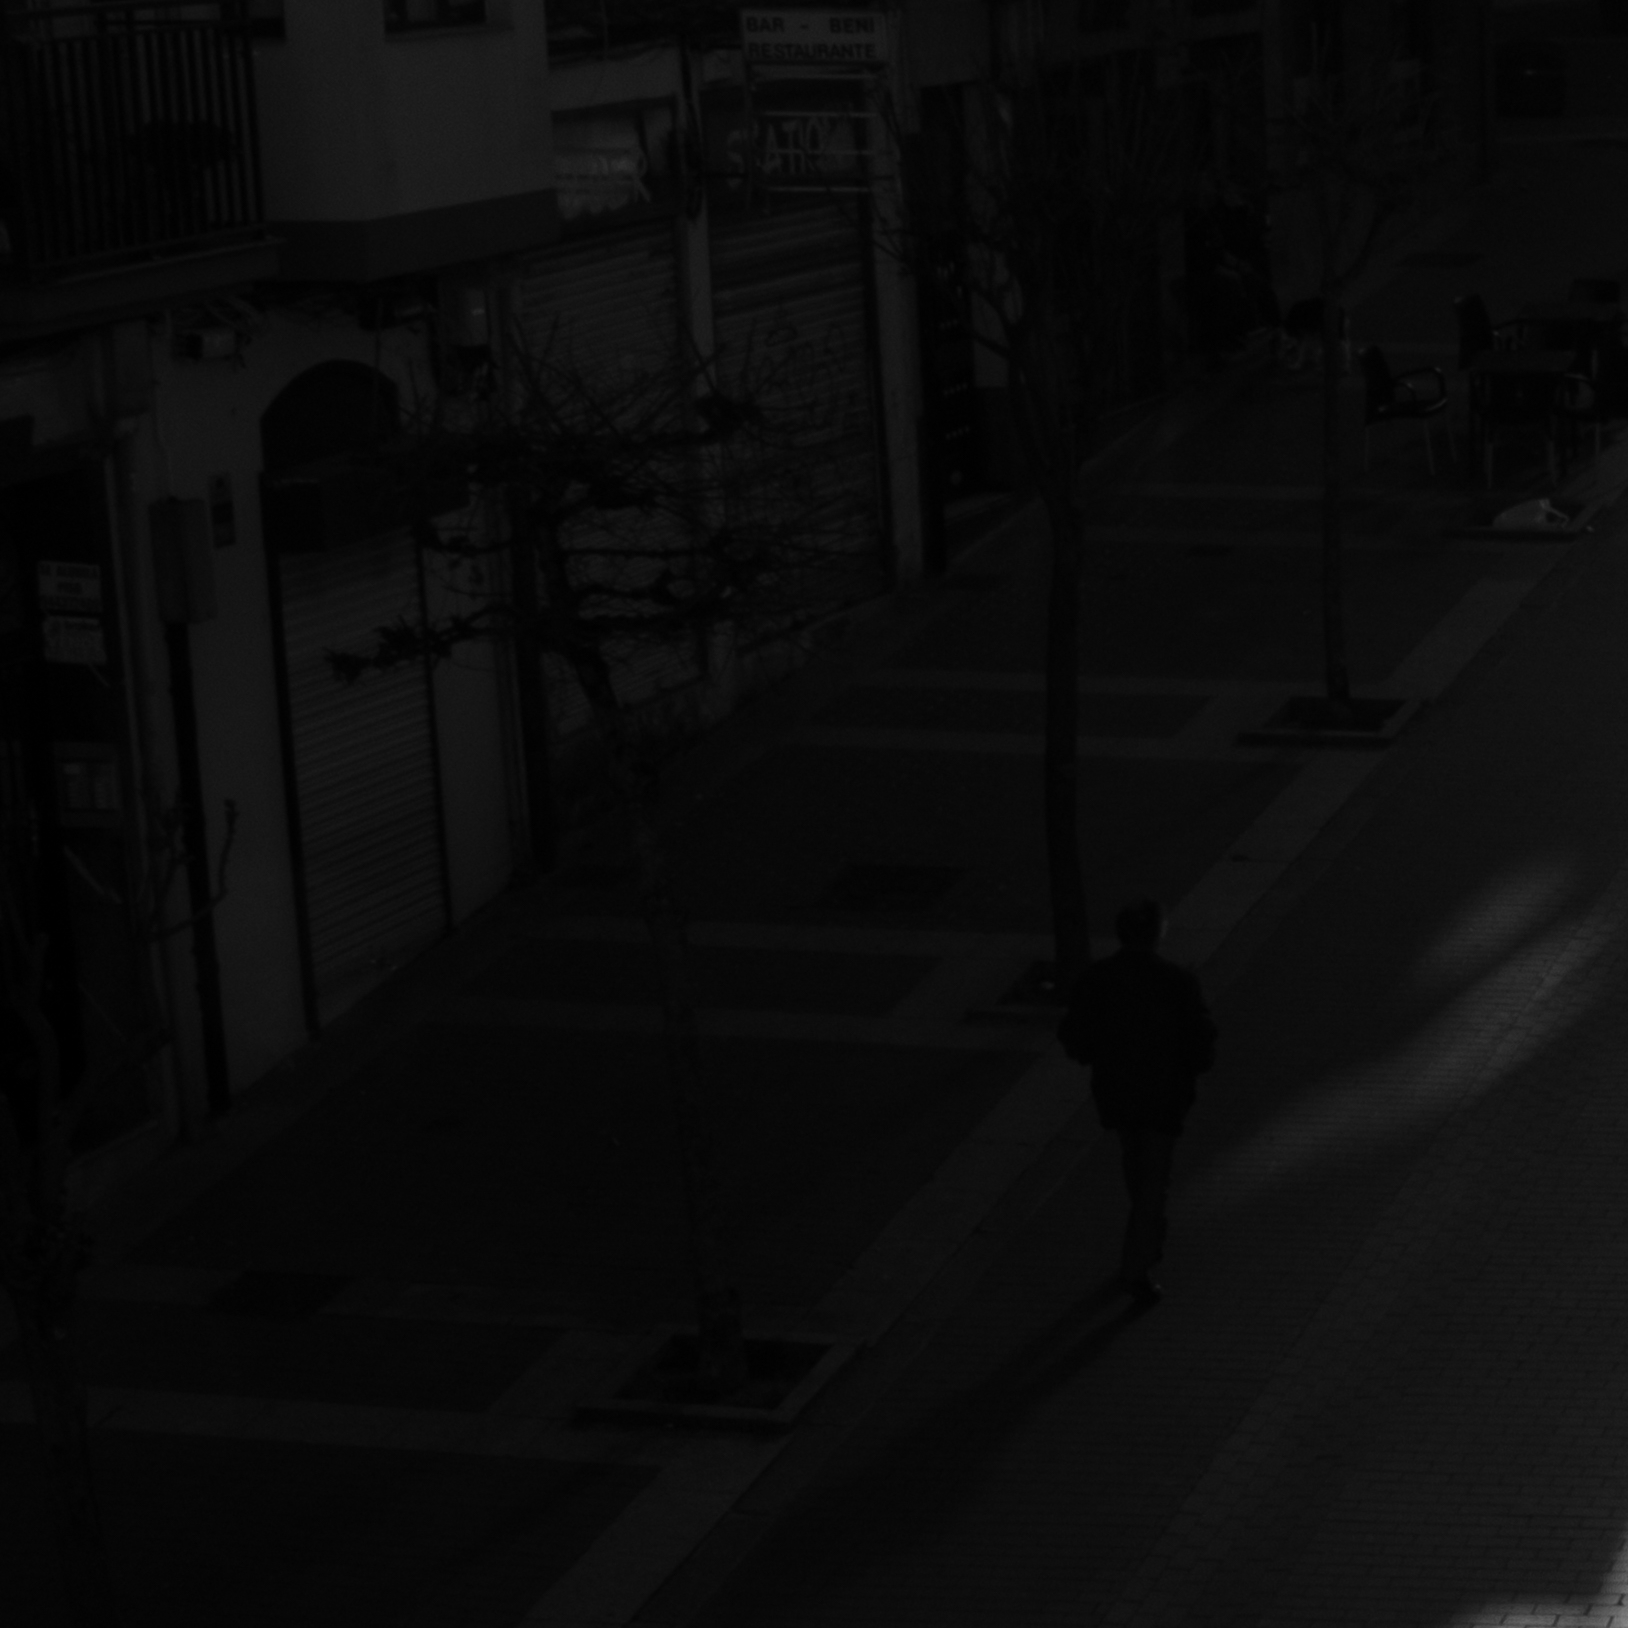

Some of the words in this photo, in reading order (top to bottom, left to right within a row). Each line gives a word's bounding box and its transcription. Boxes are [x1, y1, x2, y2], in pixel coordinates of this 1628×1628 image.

[746, 16, 785, 33] BAR
[829, 17, 875, 34] BENI
[748, 42, 876, 59] RESTAURANTE
